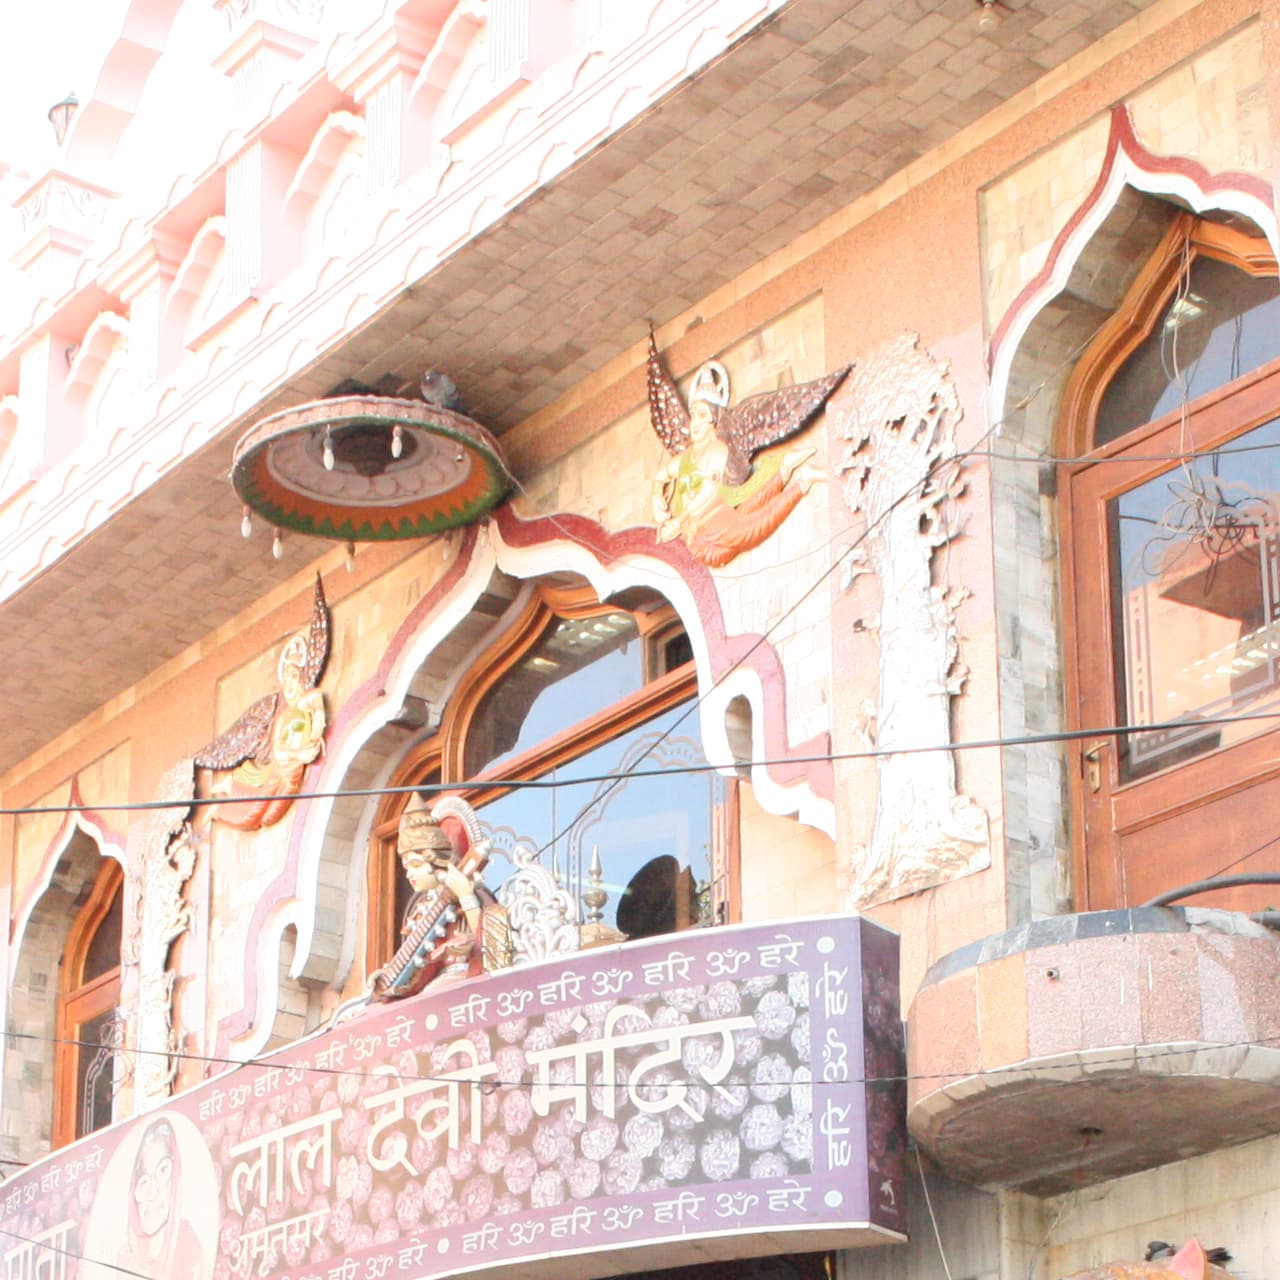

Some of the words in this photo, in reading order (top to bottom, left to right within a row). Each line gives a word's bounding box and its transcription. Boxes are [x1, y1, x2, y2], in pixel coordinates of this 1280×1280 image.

[199, 1093, 226, 1121] हरि
[253, 1068, 281, 1101] हरि
[315, 1041, 348, 1076] हरि
[386, 1015, 416, 1048] हरे
[448, 993, 492, 1028] हरि
[537, 970, 587, 1006] हरि
[641, 951, 697, 986] हरि
[757, 933, 805, 968] हरे
[815, 962, 849, 1018] हरे
[230, 1108, 343, 1216] लाल
[362, 1038, 499, 1177] देवी
[525, 1004, 757, 1124] मंदिर
[819, 1098, 852, 1170] हरि
[229, 1207, 332, 1278] अमृतसर
[398, 1237, 429, 1269] हरे
[461, 1224, 504, 1254] हरि
[549, 1207, 598, 1239] हरि
[652, 1191, 706, 1222] हरि
[765, 1179, 813, 1213] हरे
